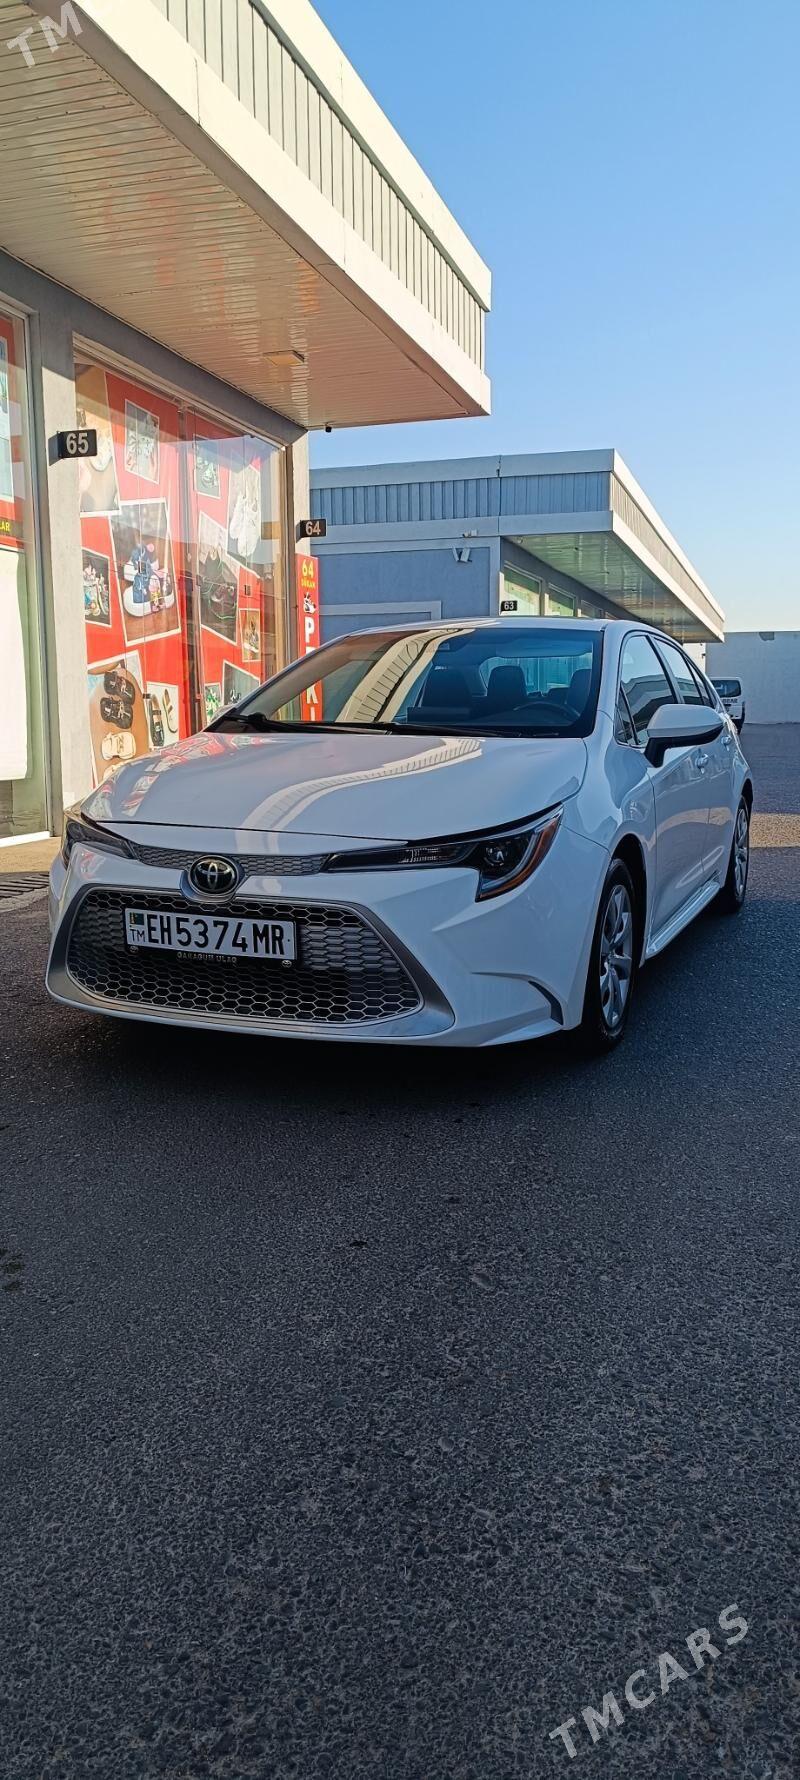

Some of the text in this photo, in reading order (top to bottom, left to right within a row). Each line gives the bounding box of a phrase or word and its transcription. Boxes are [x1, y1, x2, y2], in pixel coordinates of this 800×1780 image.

[66, 432, 89, 455] 65
[305, 520, 321, 536] 64
[302, 559, 314, 578] 64
[504, 601, 515, 611] 63
[130, 928, 146, 943] TM
[147, 914, 285, 956] EH5374MR
